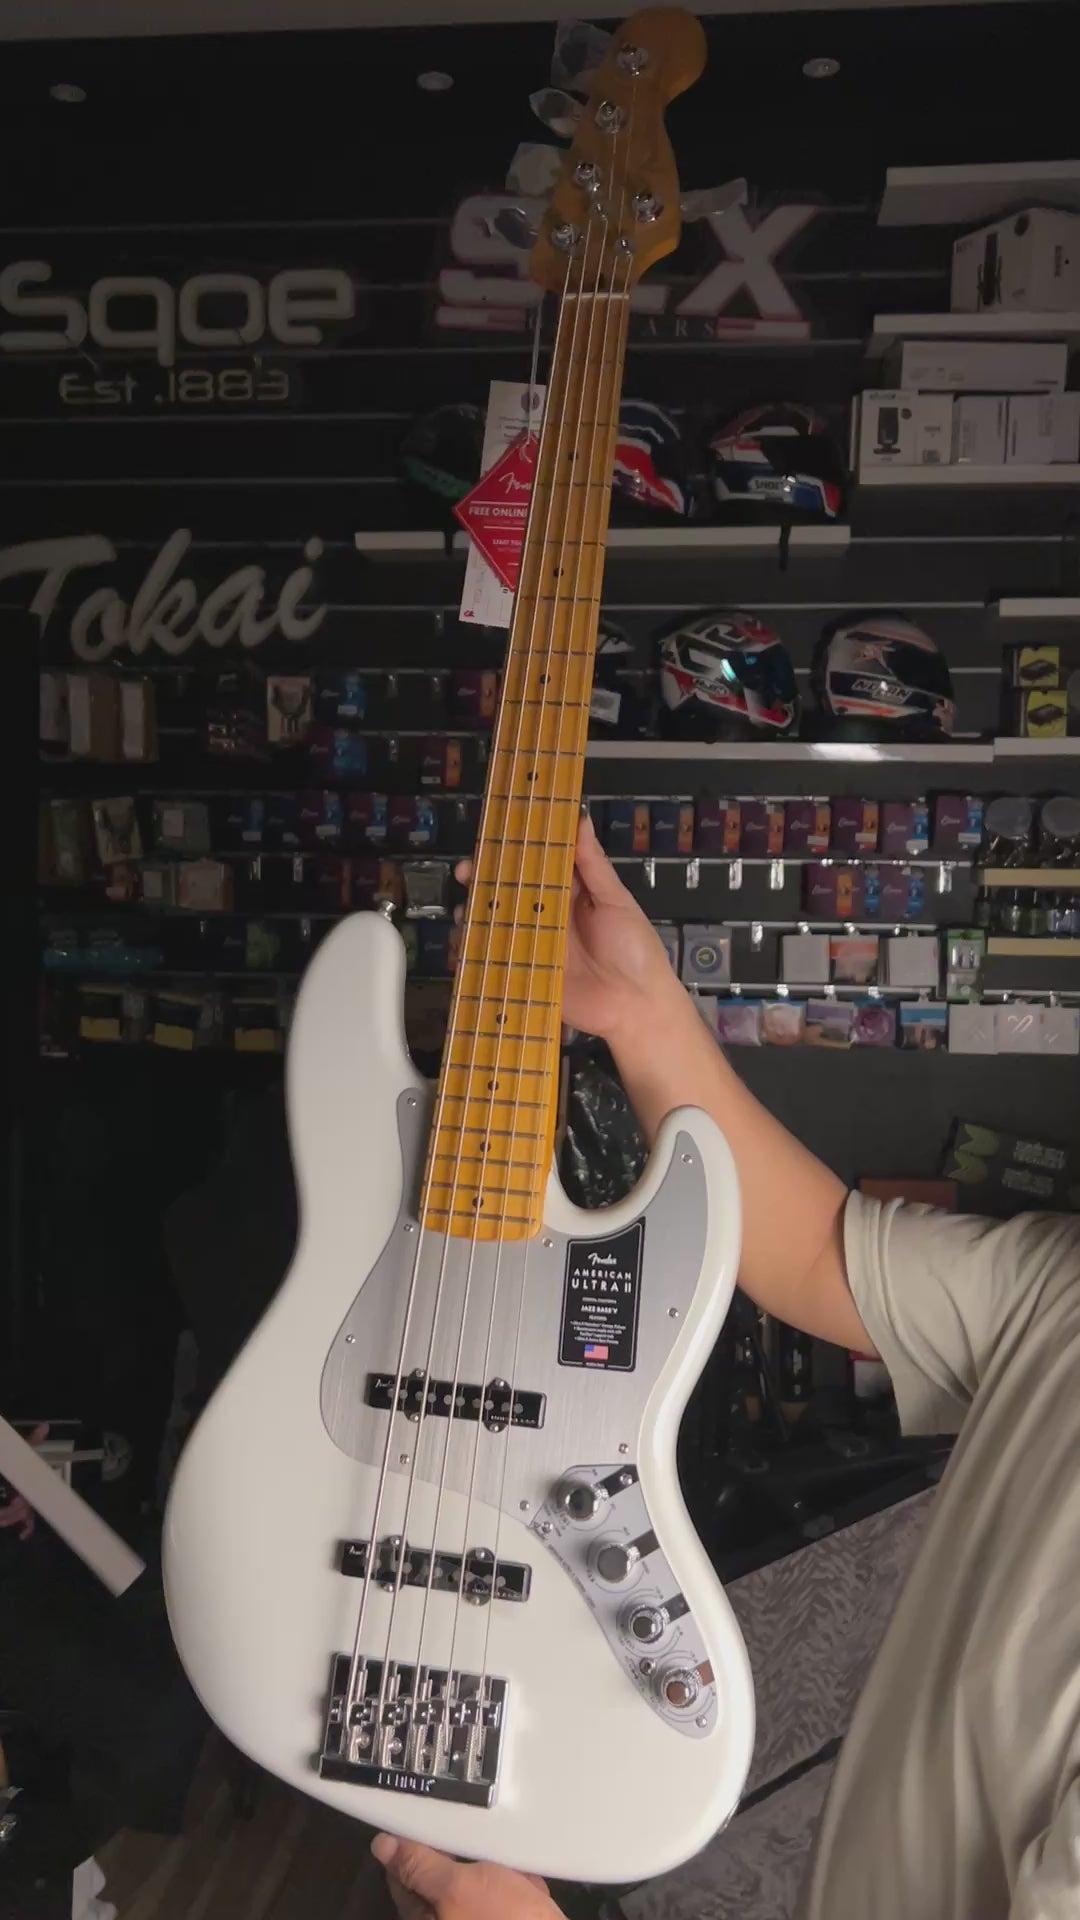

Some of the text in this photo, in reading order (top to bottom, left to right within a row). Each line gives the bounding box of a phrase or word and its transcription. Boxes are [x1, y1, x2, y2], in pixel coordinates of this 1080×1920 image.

[0, 260, 355, 368] Sqoe
[58, 373, 138, 404] Est
[468, 507, 489, 516] FREE
[0, 528, 328, 661] Tokai
[587, 1252, 617, 1266] Fender
[574, 1268, 632, 1280] AMERICAN
[571, 1278, 632, 1293] ULTRA II
